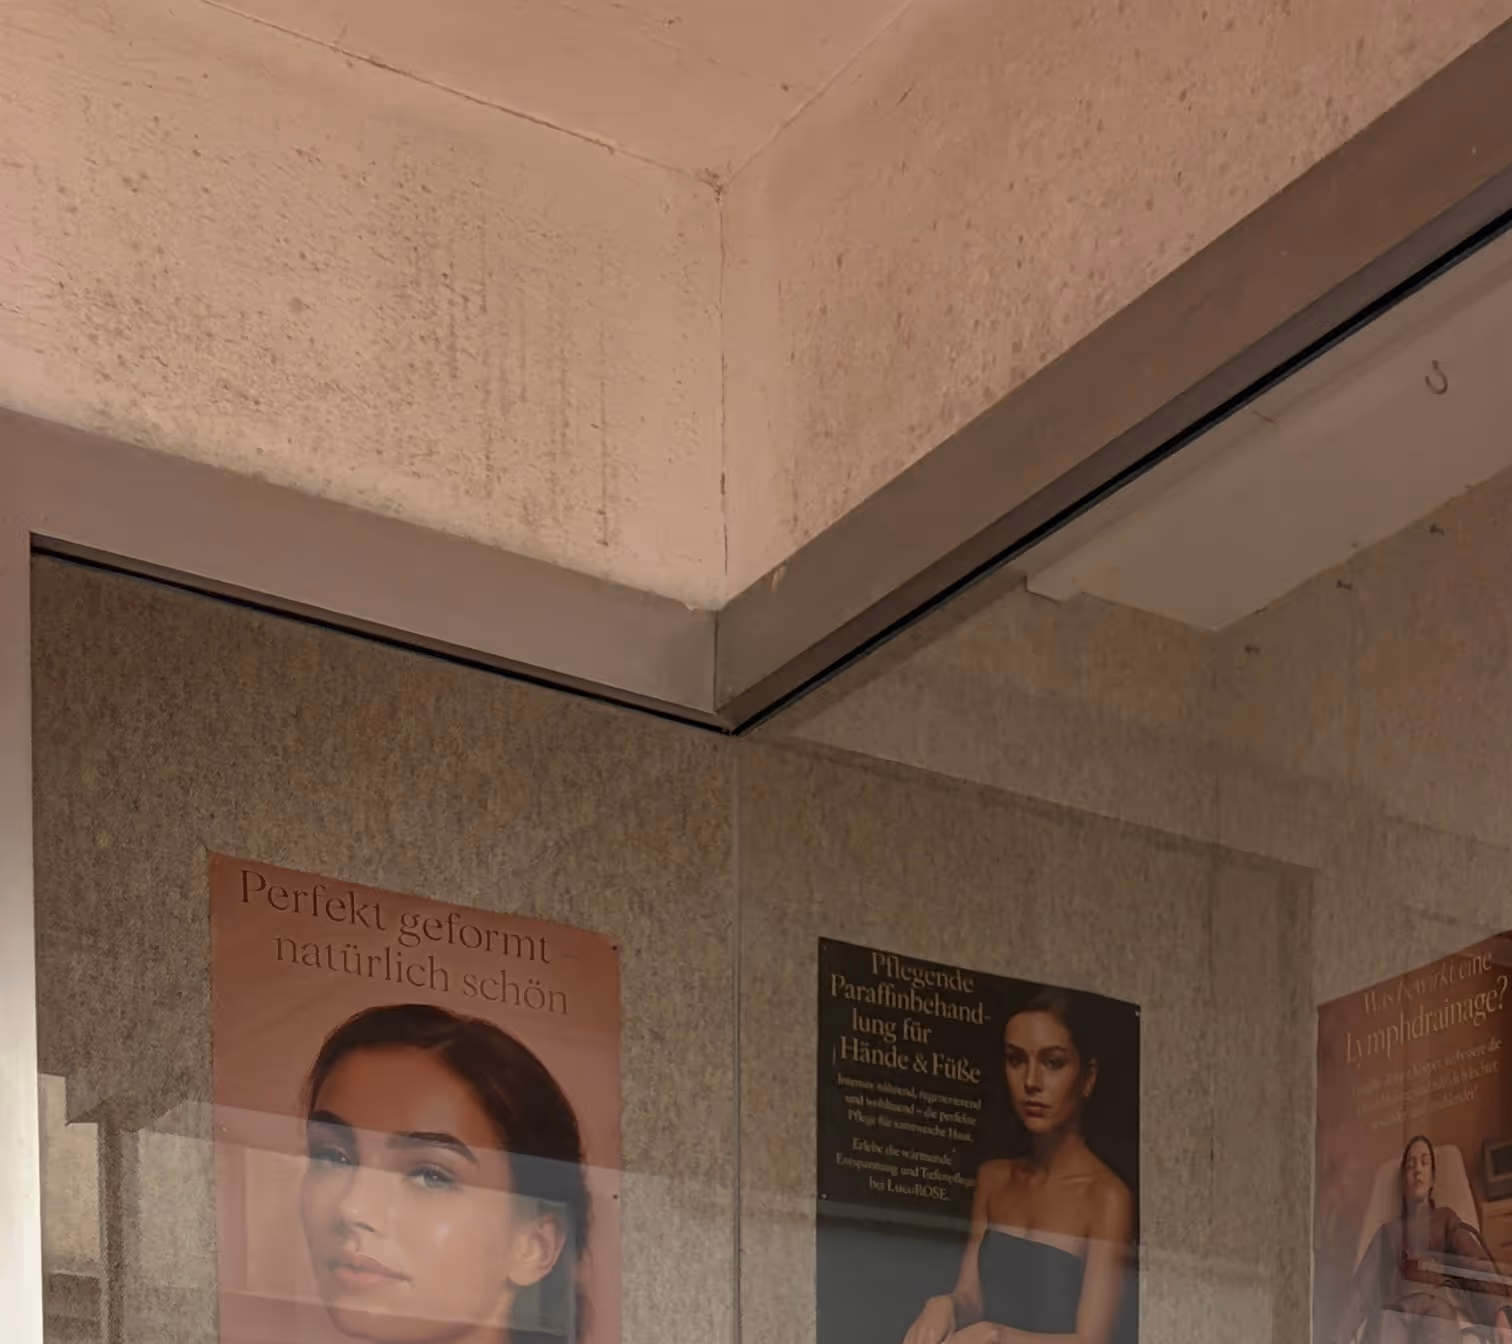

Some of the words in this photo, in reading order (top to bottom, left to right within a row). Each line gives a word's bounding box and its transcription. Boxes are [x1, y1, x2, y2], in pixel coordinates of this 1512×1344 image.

[240, 867, 388, 932] Perfekt
[399, 911, 553, 965] geformt
[275, 935, 450, 994] natürlich
[462, 968, 569, 1016] schön
[870, 950, 975, 994] Pflegende
[831, 972, 992, 1026] Paraffinbehand-
[852, 1007, 898, 1045] lung
[903, 1018, 933, 1045] für
[839, 1035, 909, 1072] Hände
[912, 1054, 930, 1074] &
[932, 1052, 982, 1084] Füße
